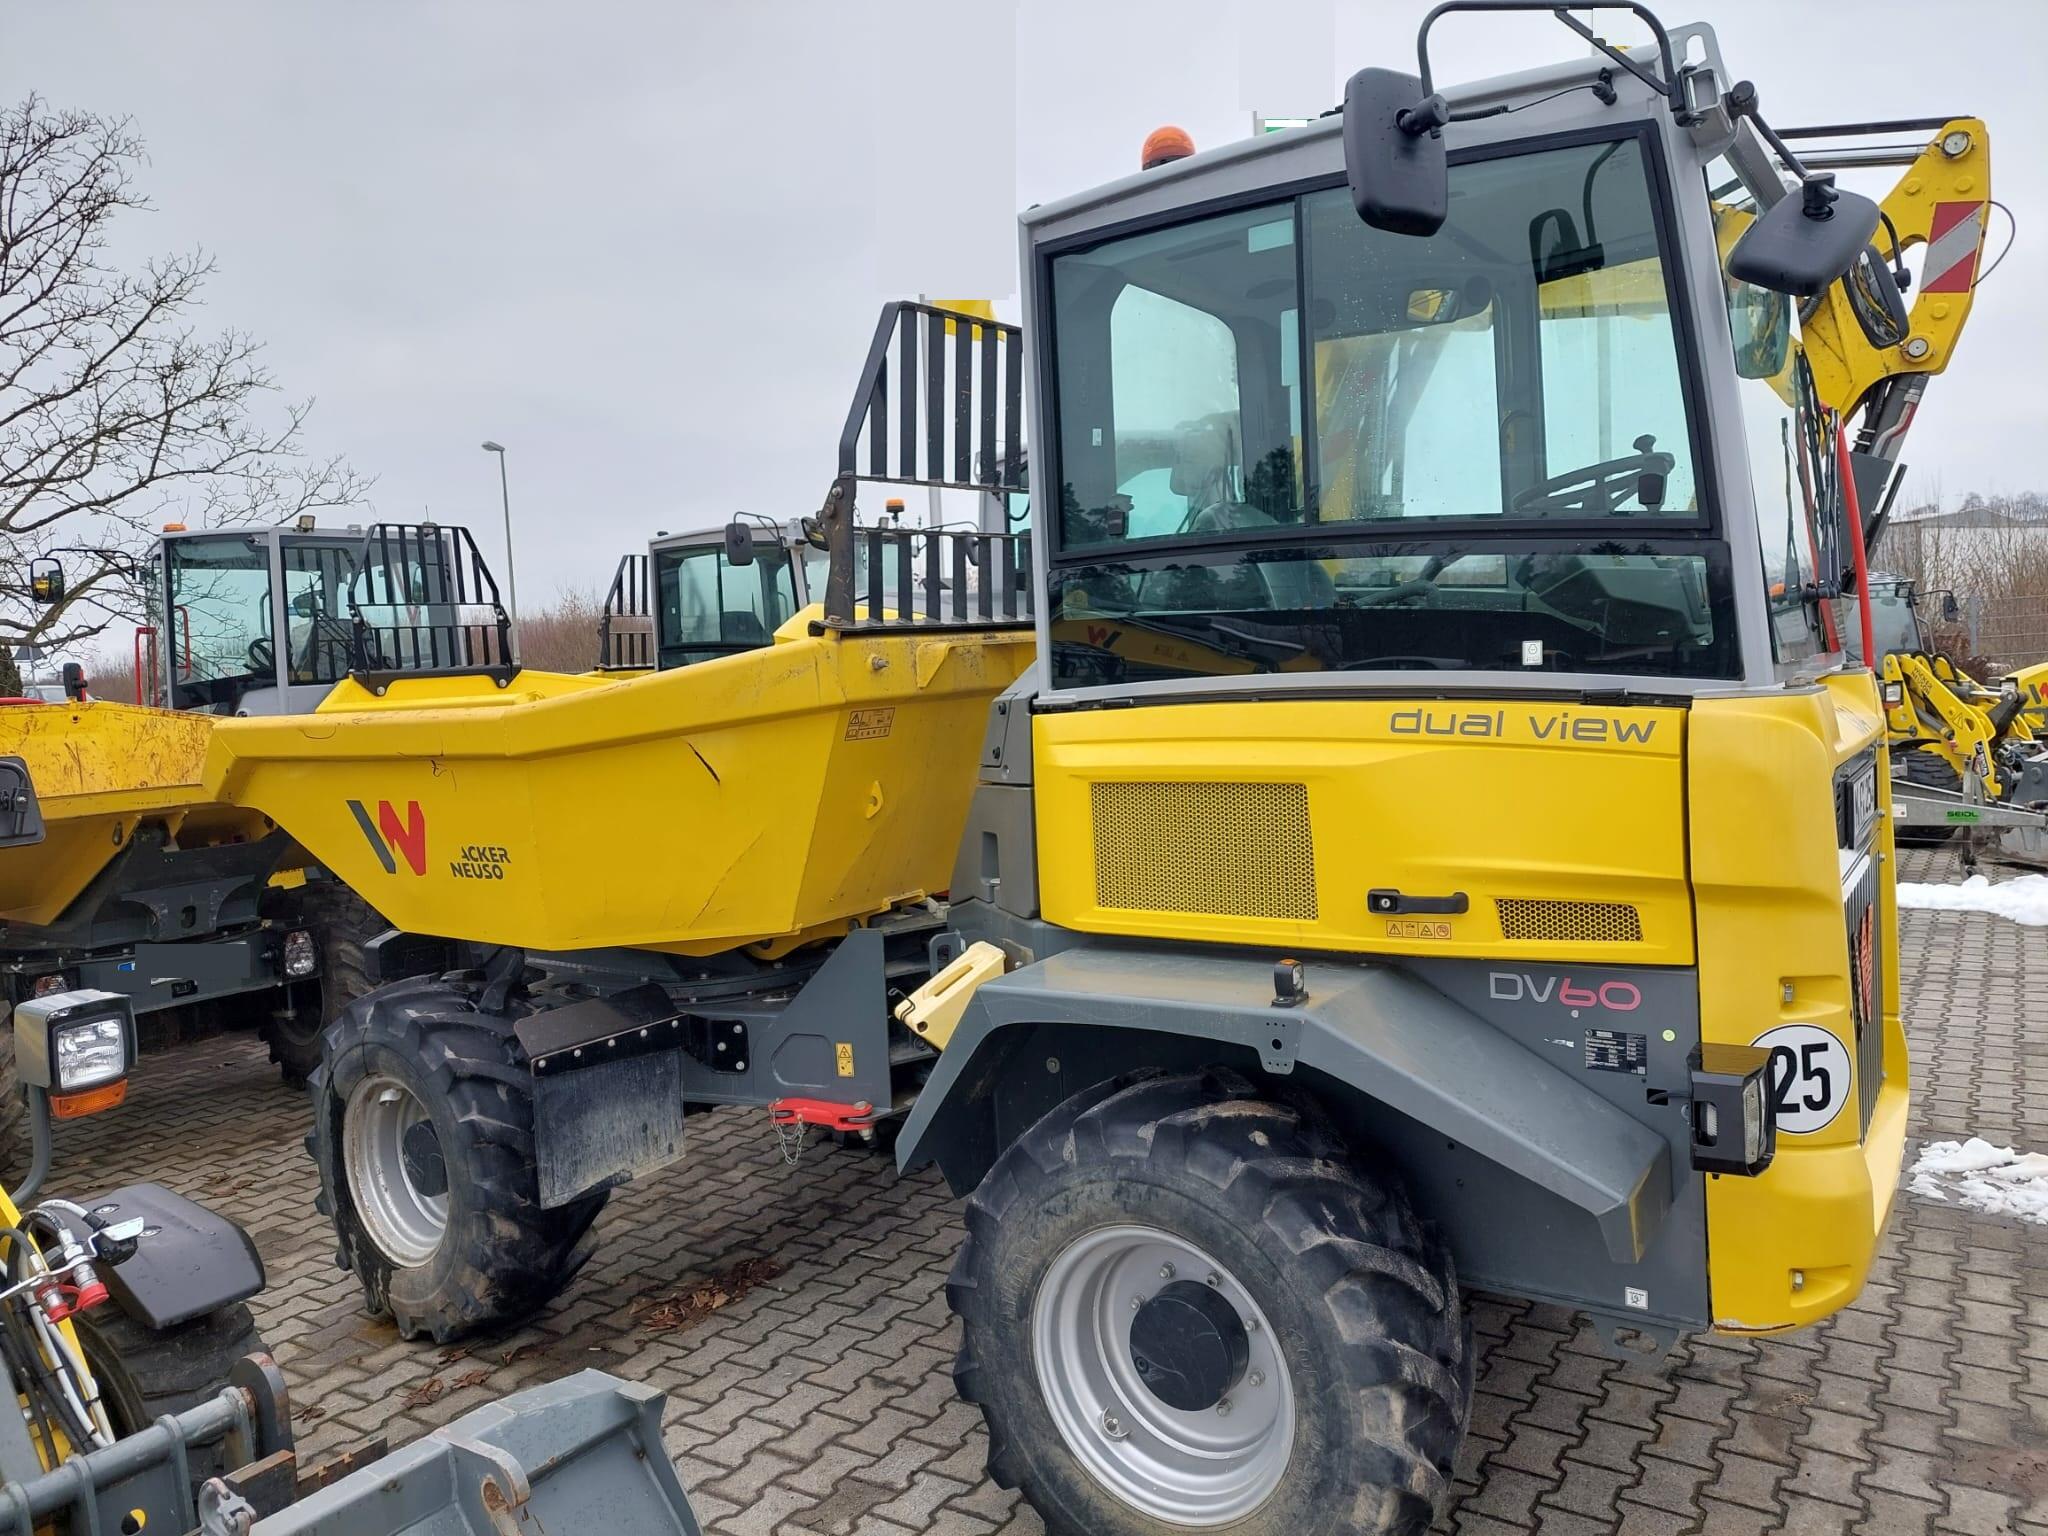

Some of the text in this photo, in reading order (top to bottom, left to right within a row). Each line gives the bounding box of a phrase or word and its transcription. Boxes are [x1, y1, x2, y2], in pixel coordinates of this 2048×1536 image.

[1390, 708, 1657, 743] dual view
[450, 862, 503, 880] NEUSO
[1489, 972, 1642, 1011] DV60
[1773, 1042, 1831, 1113] 25
